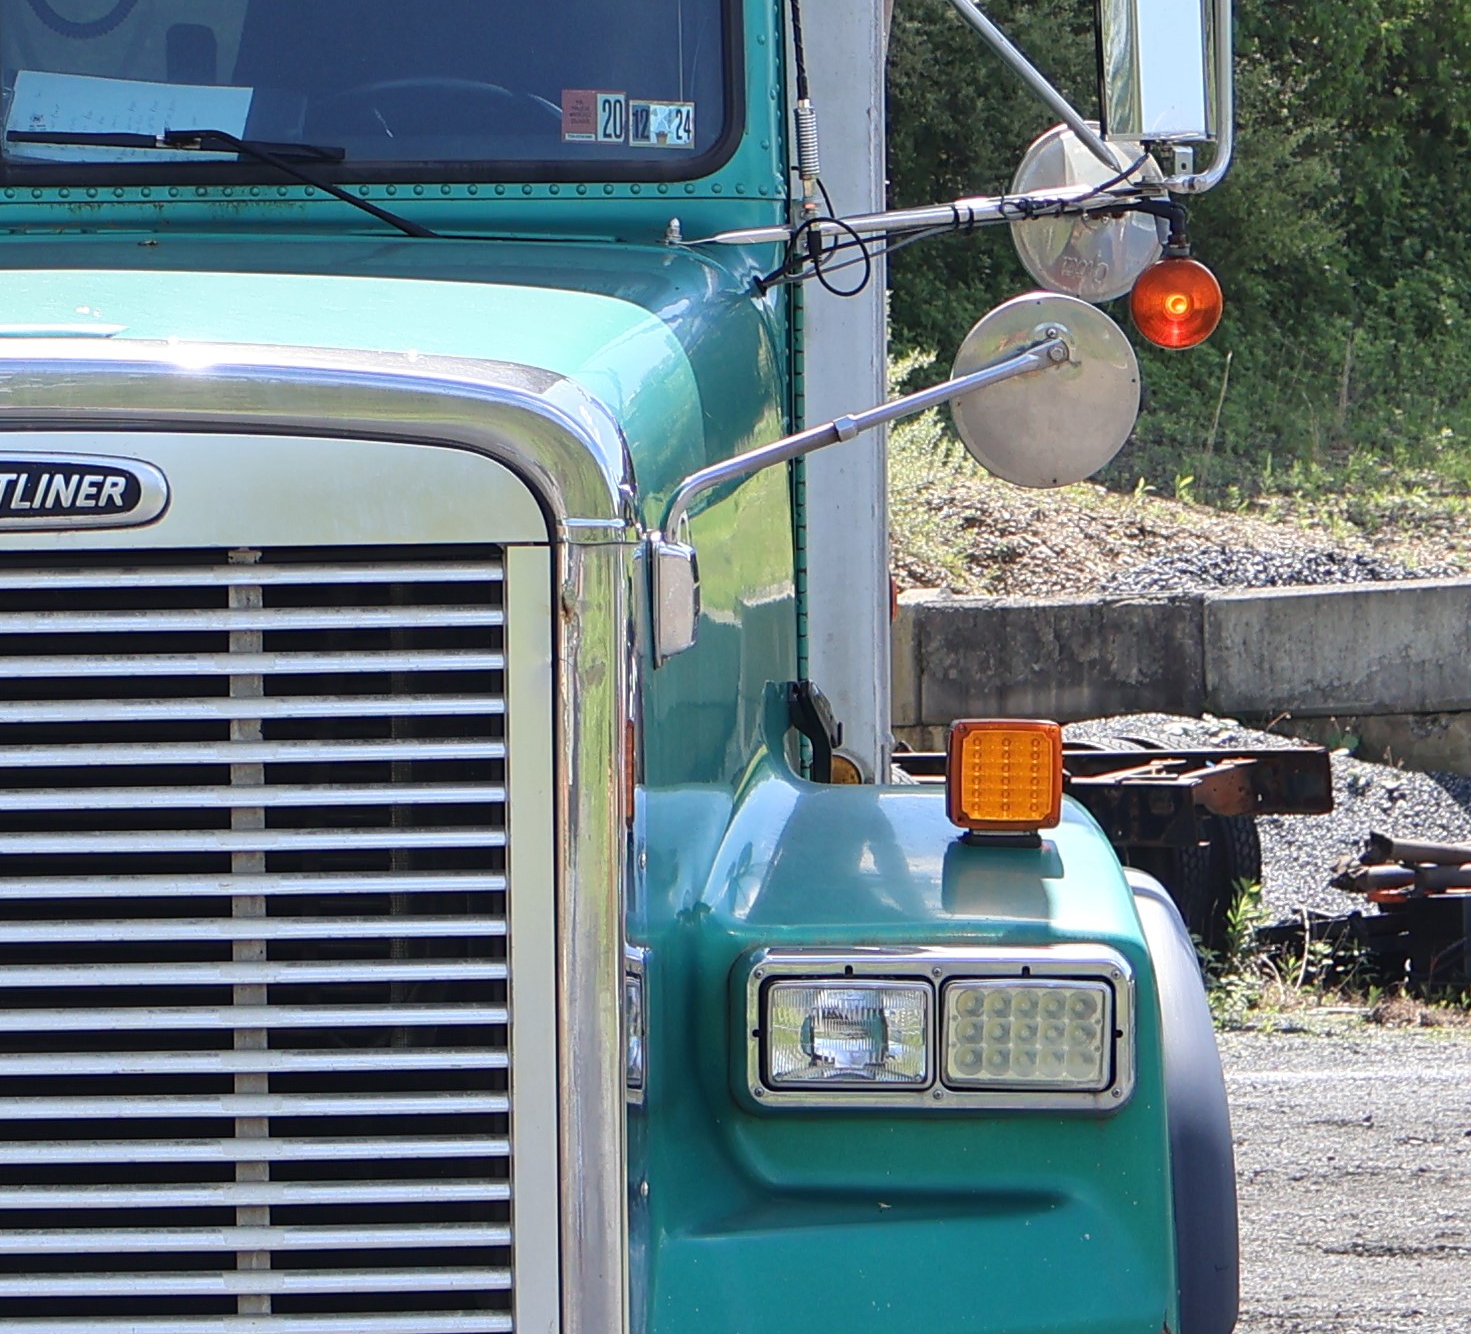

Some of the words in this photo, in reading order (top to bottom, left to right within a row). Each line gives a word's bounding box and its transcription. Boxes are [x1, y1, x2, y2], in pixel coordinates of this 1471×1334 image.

[602, 99, 623, 139] 20
[633, 109, 649, 140] 12
[675, 109, 691, 140] 24
